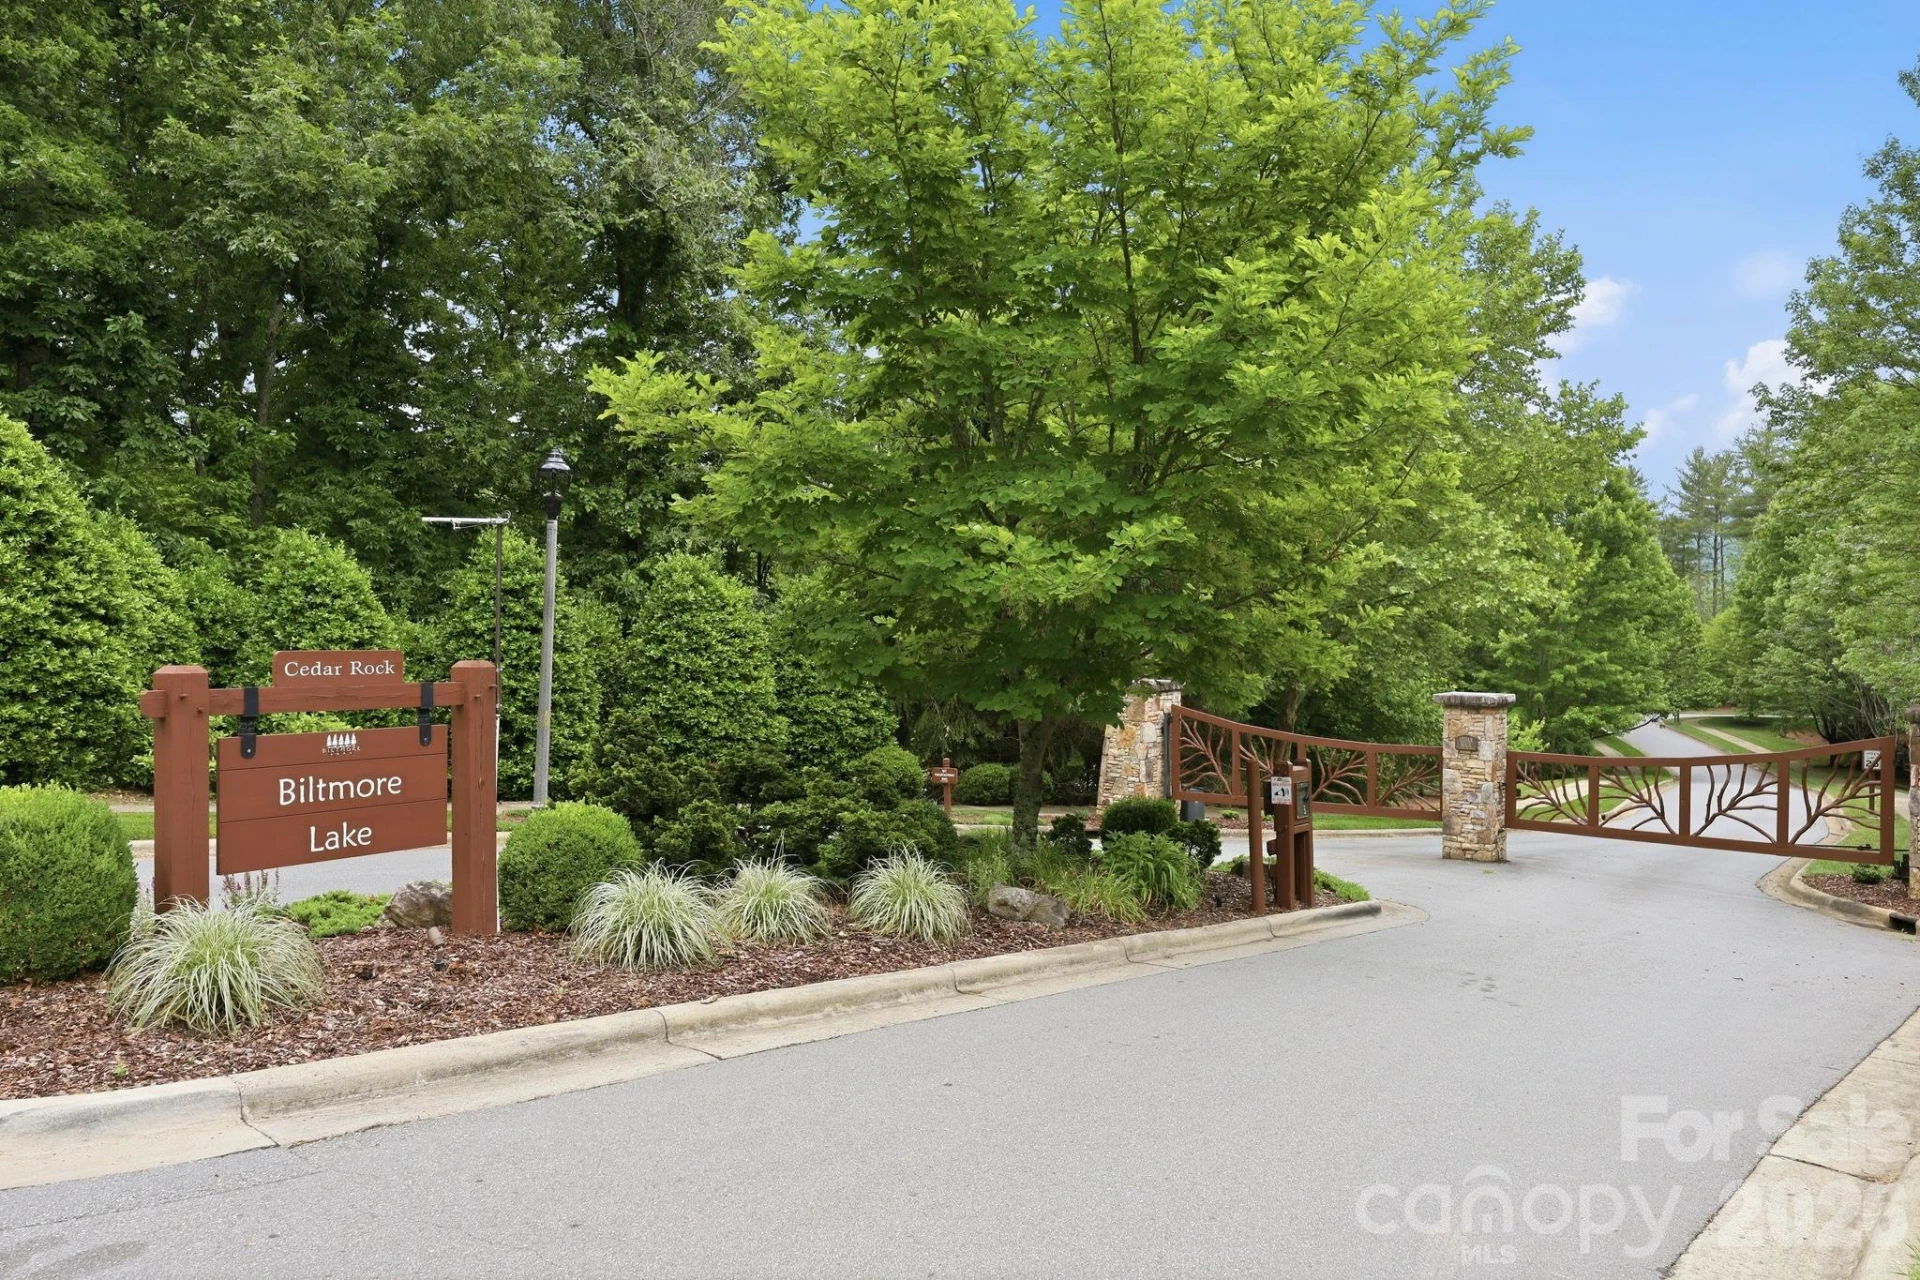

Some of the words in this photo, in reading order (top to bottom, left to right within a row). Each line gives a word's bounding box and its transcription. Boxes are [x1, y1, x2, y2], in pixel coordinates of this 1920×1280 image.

[284, 661, 342, 677] Cedar
[349, 660, 395, 676] Rock
[279, 776, 402, 806] Biltmore
[310, 821, 372, 852] Lake
